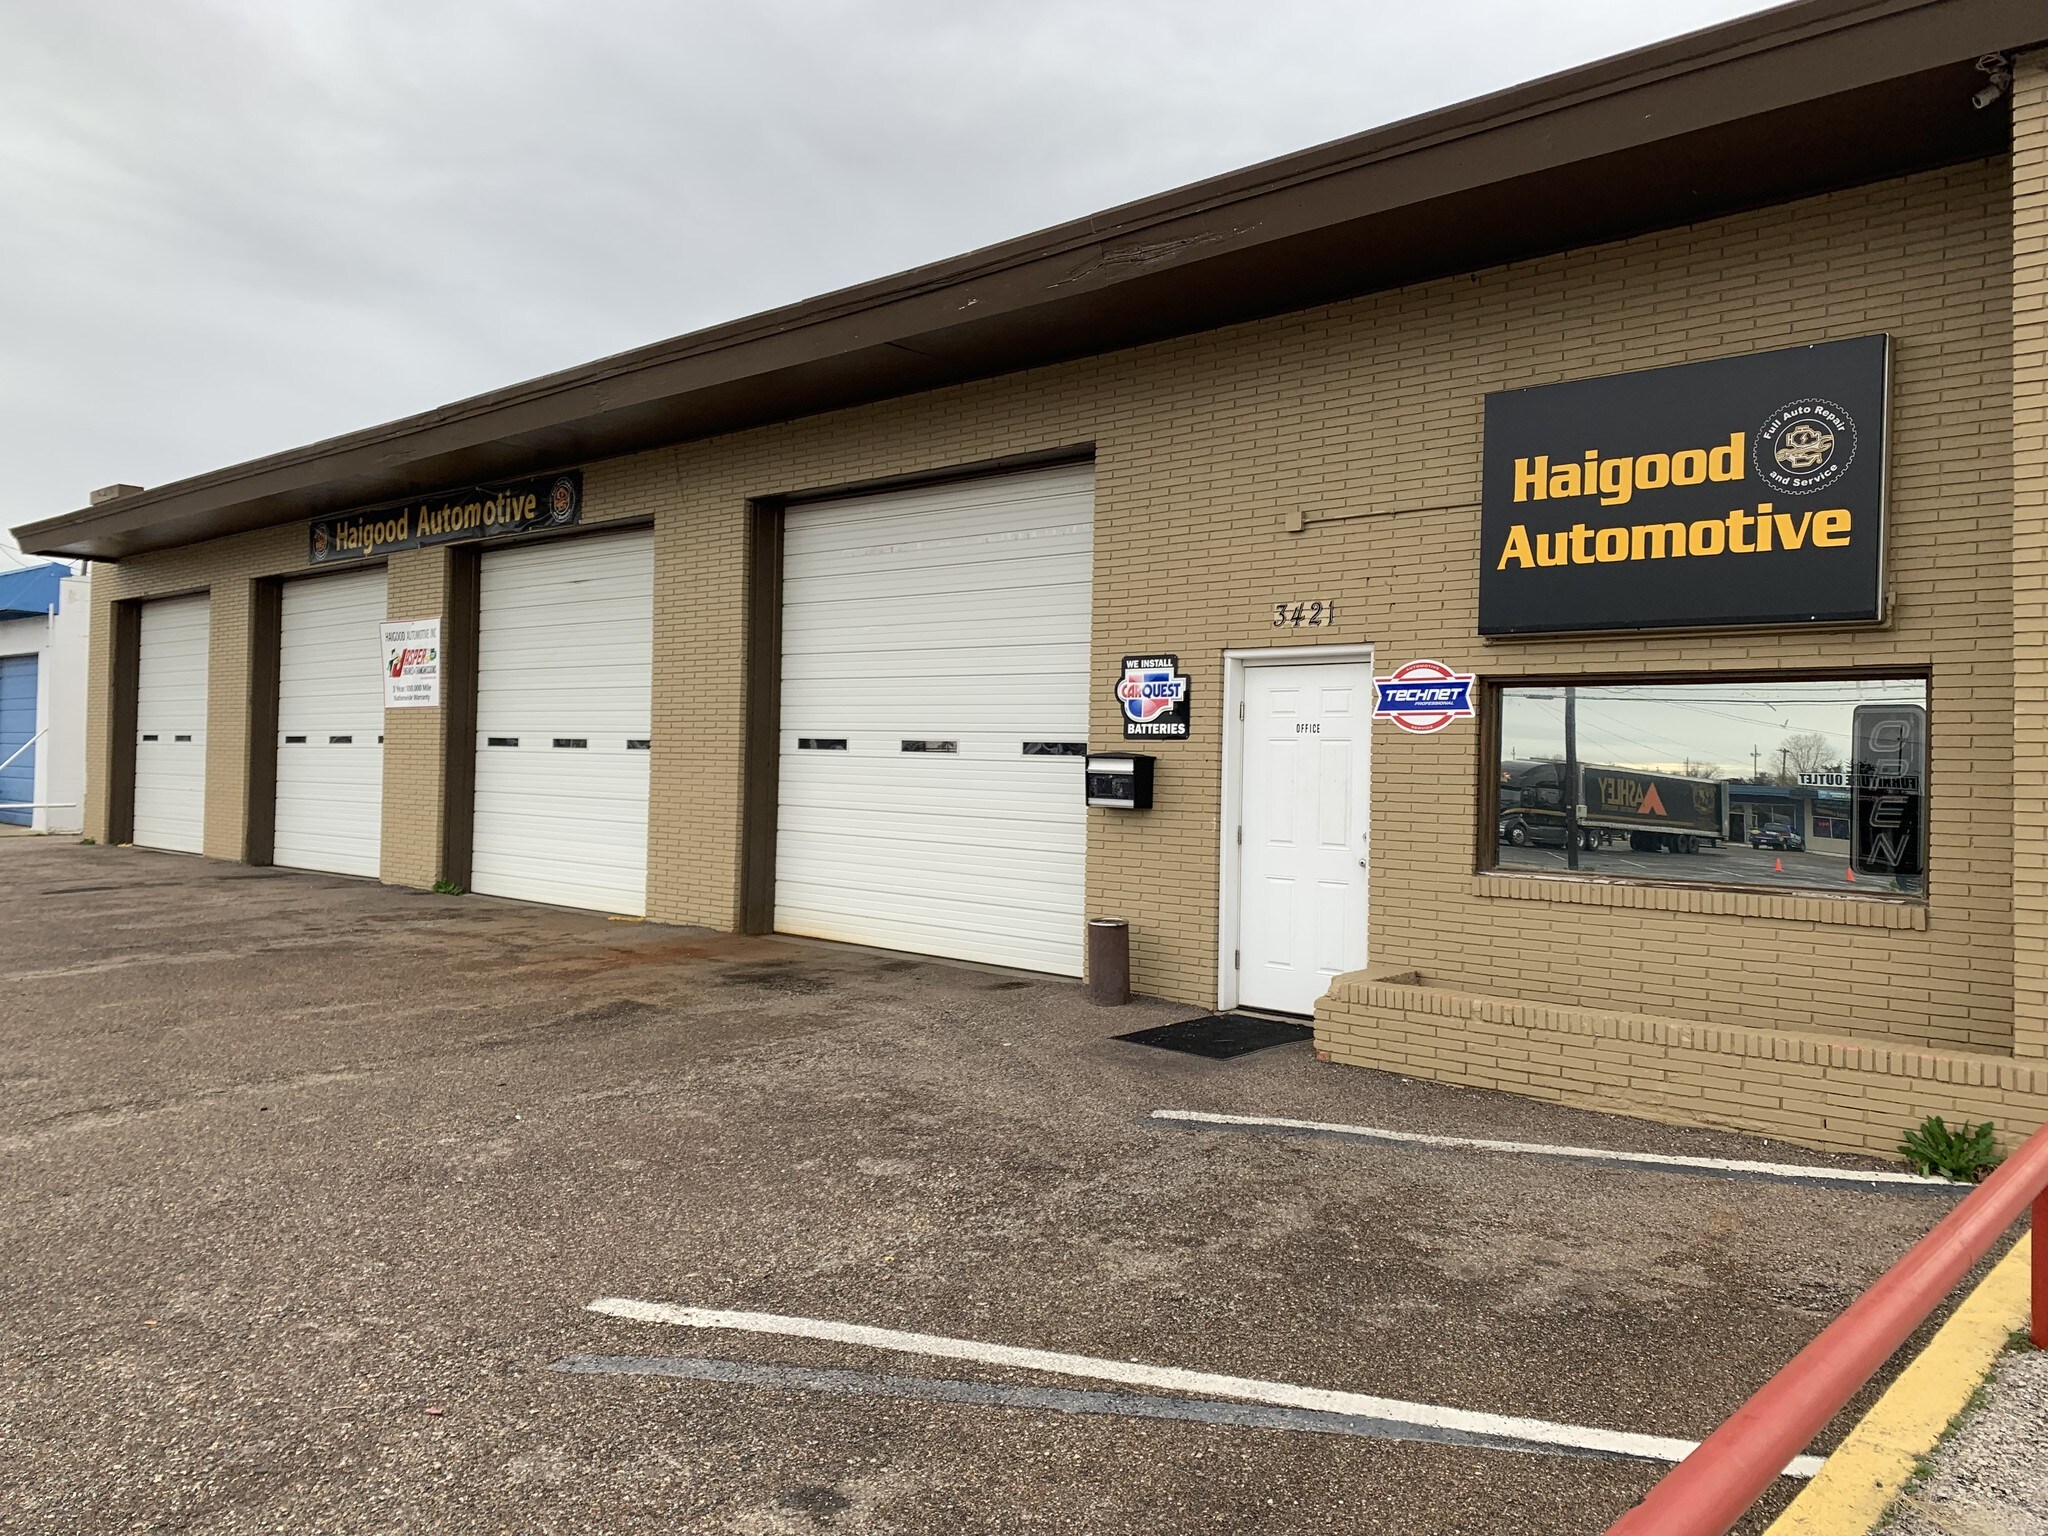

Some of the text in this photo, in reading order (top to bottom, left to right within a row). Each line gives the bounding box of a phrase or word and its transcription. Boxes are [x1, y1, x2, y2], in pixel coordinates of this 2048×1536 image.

[1763, 405, 1846, 440] Full Auto Repair
[1513, 432, 1746, 506] Haigood
[1769, 464, 1838, 487] and Service
[336, 508, 409, 554] Haigood
[416, 489, 537, 537] Automotive
[1497, 503, 1852, 570] Automotive
[1273, 600, 1335, 628] 3421
[1126, 658, 1173, 669] WE INSTALL
[1121, 682, 1181, 699] CARQUEST
[1127, 723, 1186, 735] BATTERIES
[1296, 723, 1321, 734] OFFICE
[1866, 720, 1910, 867] OPEN
